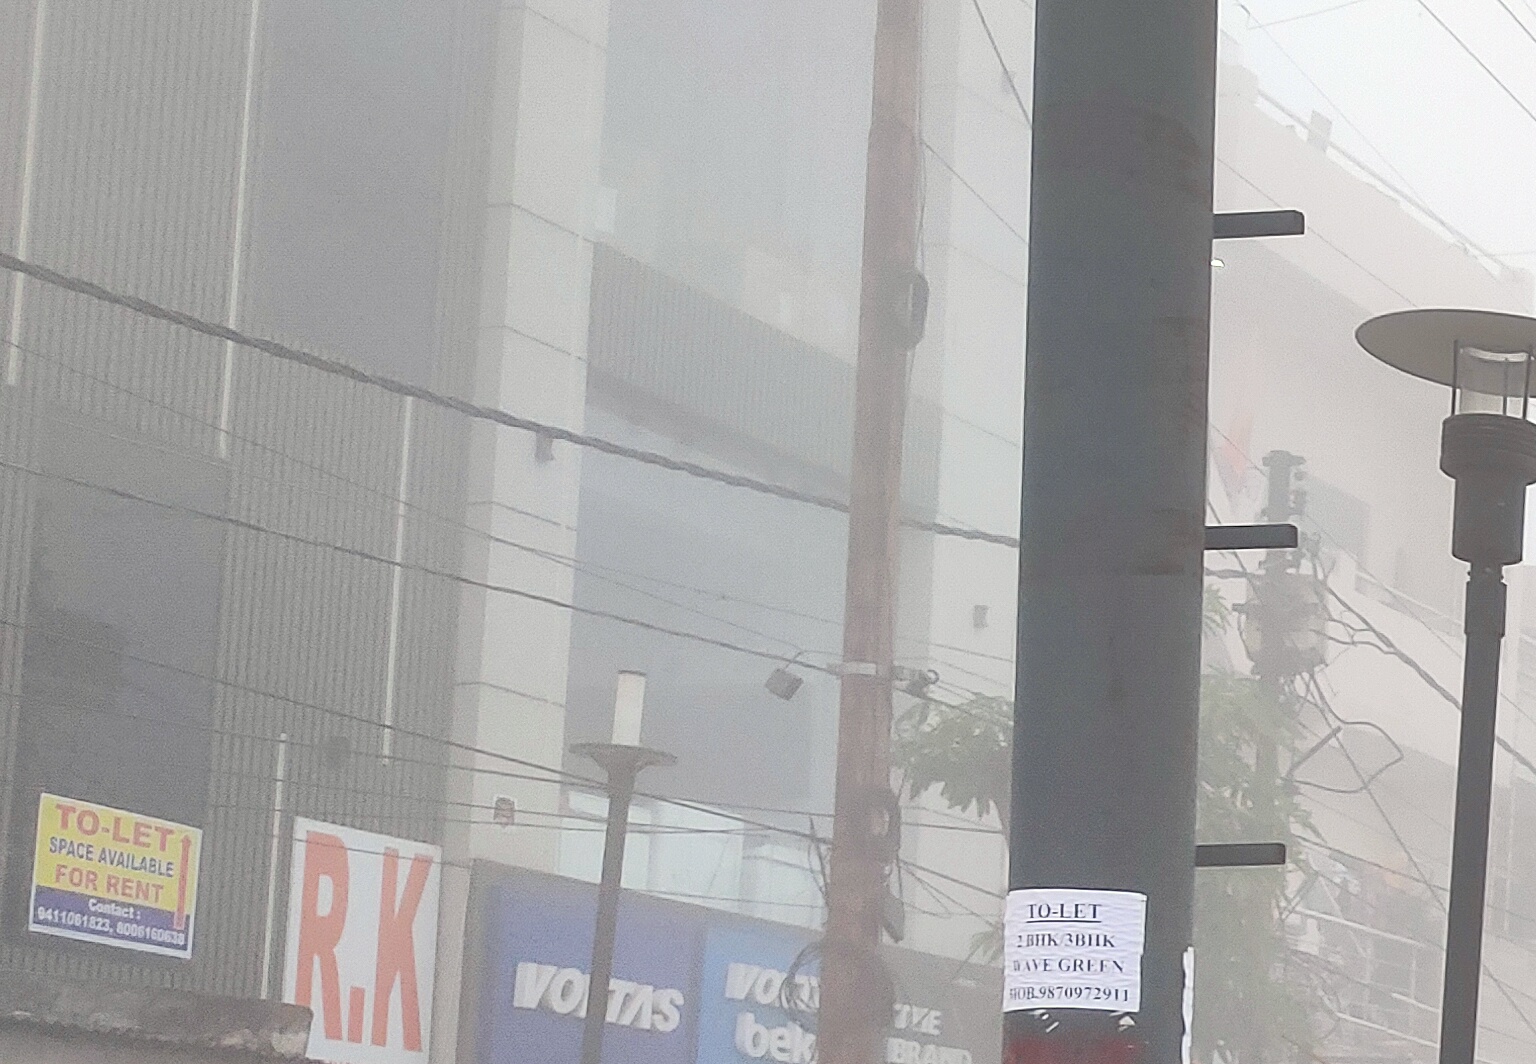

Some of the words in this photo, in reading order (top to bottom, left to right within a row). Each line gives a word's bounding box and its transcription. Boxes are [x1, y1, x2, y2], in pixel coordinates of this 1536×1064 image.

[56, 803, 175, 852] TO-LET
[49, 836, 94, 862] SPACE
[98, 847, 175, 877] AVAILABLE
[55, 864, 98, 892] FOR
[106, 873, 164, 903] RENT
[88, 898, 135, 919] Contact
[1027, 903, 1102, 919] TO-LET
[295, 830, 434, 1052] R.K
[1058, 958, 1125, 973] GREEN
